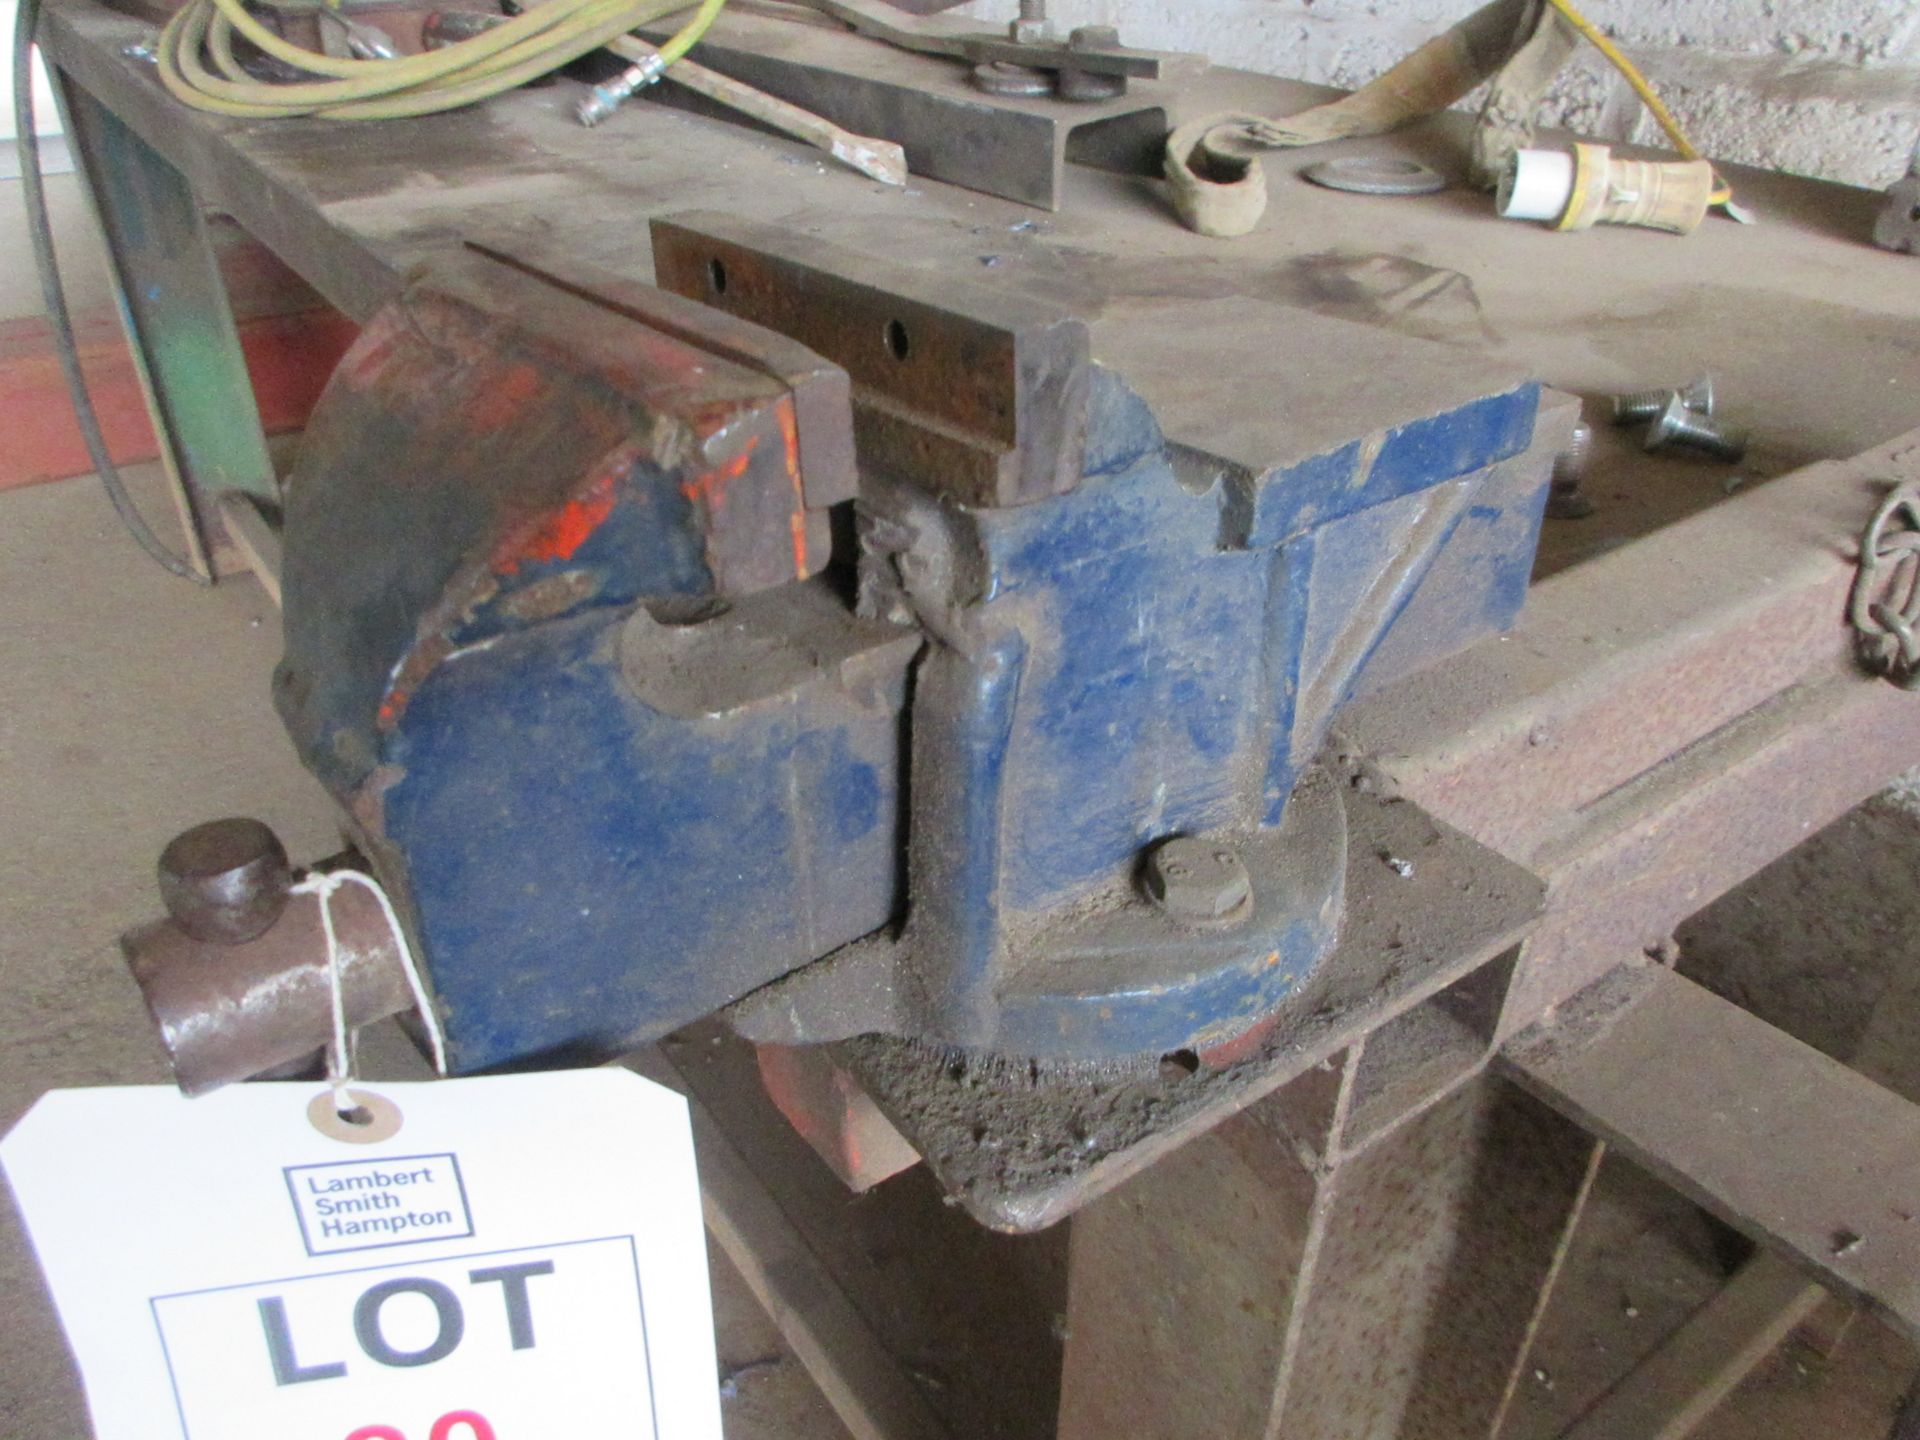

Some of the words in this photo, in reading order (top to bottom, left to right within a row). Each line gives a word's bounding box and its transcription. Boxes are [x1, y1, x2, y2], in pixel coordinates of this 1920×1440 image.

[308, 1168, 434, 1194] Lambert
[315, 1192, 400, 1216] Smith
[321, 1210, 452, 1237] Hampton
[257, 1260, 554, 1387] LOT
